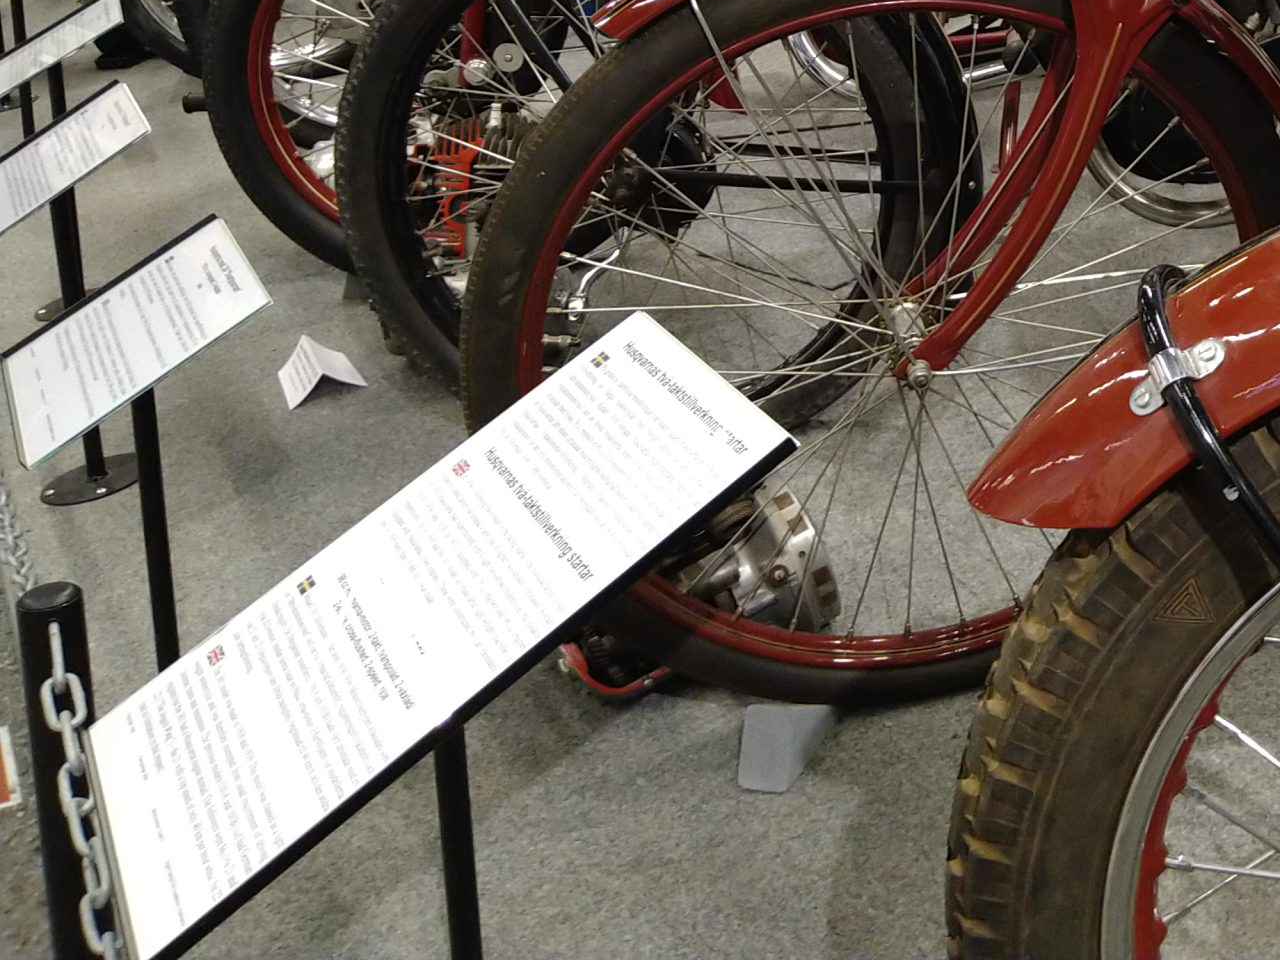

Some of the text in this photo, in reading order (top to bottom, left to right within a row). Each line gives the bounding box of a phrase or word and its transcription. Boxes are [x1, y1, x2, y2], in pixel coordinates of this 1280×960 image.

[624, 342, 660, 377] Husqvarnas
[485, 448, 518, 488] Husqvarnas
[567, 553, 593, 581] startar
